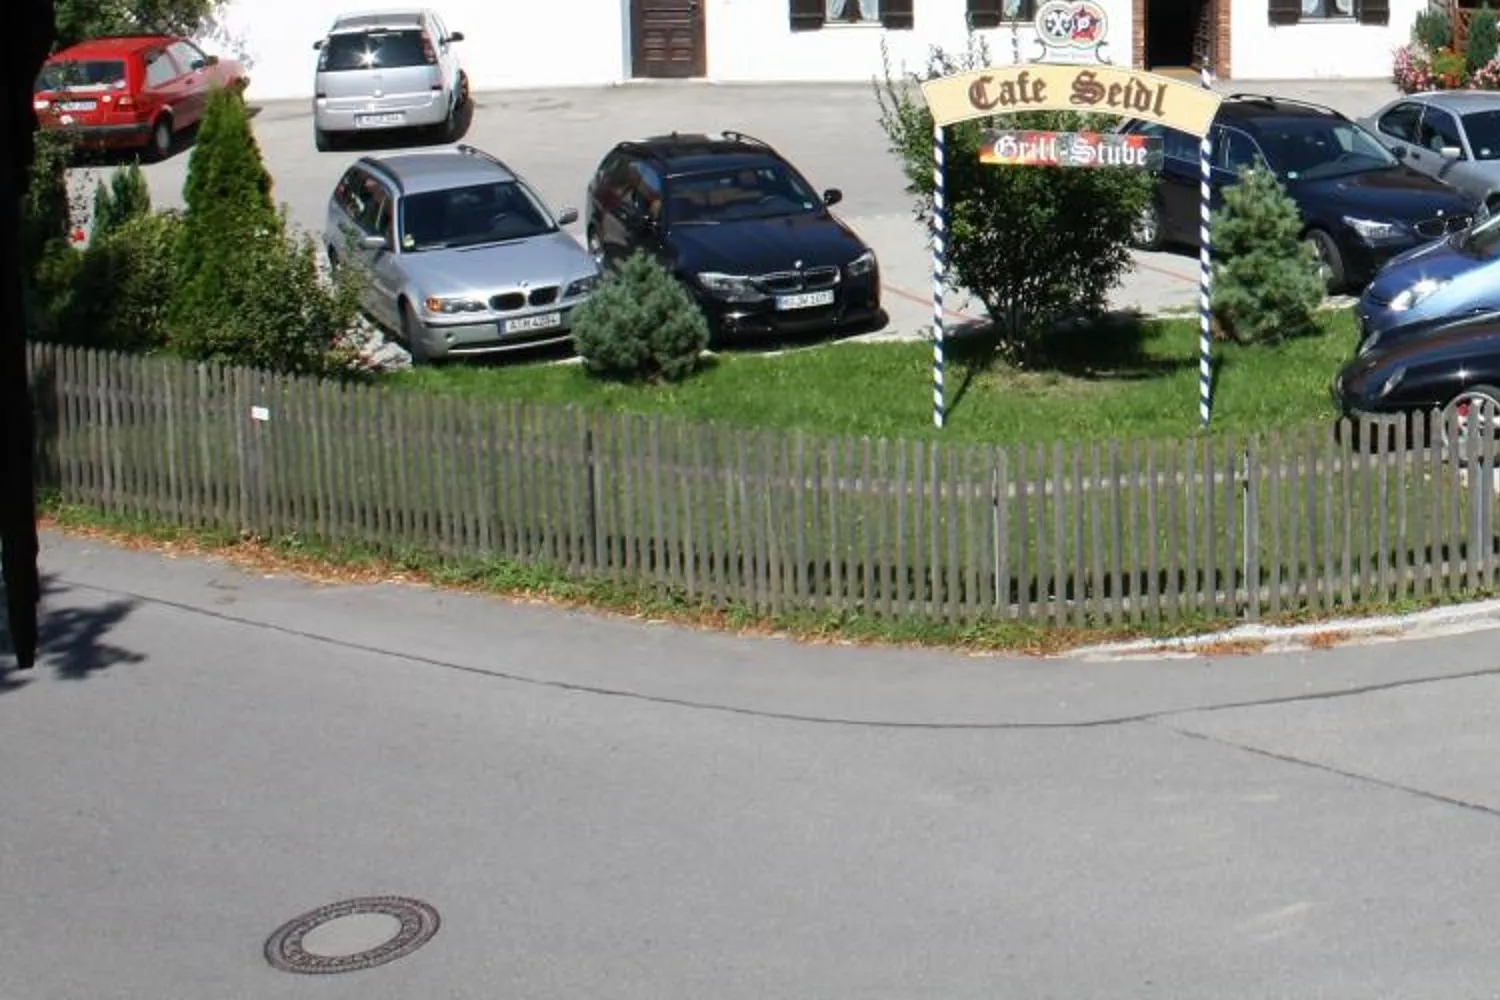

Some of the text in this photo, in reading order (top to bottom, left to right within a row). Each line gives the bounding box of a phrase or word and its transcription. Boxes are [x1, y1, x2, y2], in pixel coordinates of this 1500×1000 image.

[968, 70, 1168, 118] Cafe Seidl
[993, 134, 1148, 167] Grill-Stube
